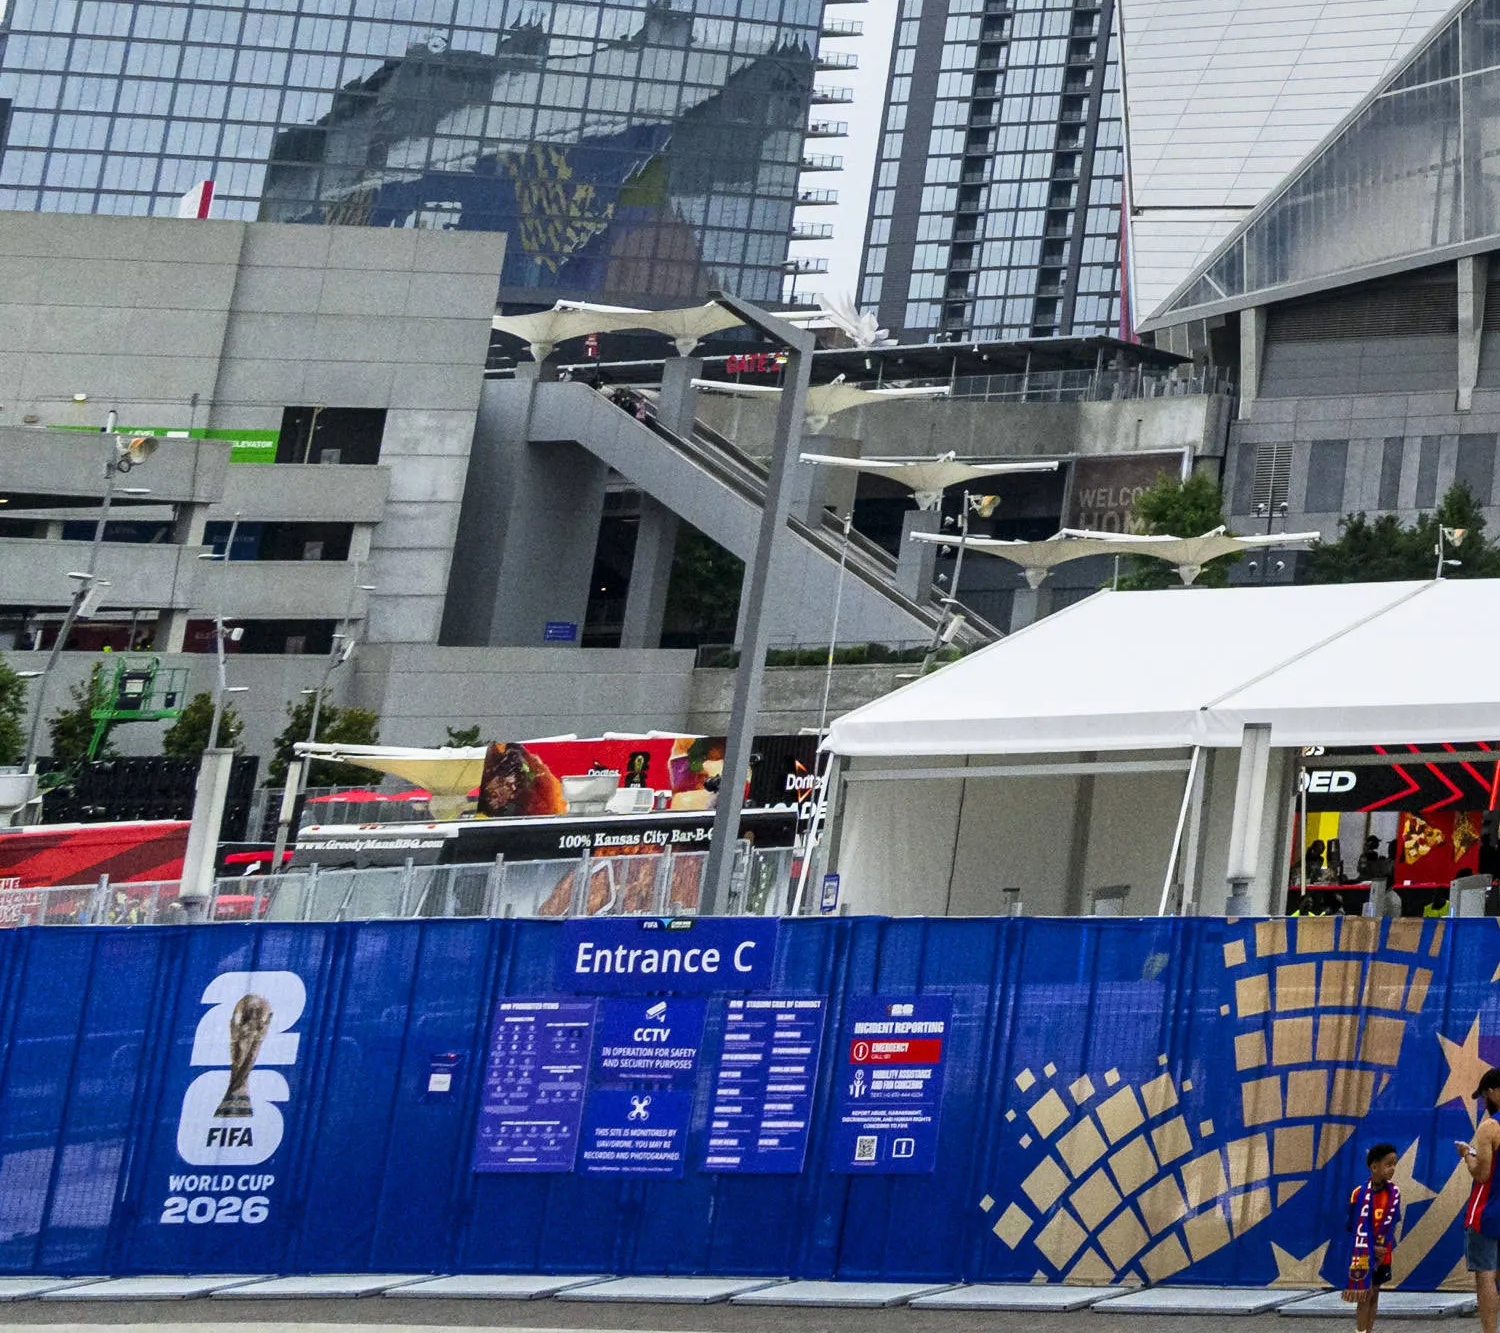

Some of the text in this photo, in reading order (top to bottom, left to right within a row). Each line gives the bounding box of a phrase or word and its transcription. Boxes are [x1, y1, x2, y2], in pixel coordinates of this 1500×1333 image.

[726, 354, 768, 374] GATE
[559, 834, 592, 849] 100%
[594, 832, 641, 848] Kansas
[643, 830, 670, 847] City
[575, 940, 757, 973] Entrance C
[854, 1021, 944, 1034] INCIDENT REPORTING
[633, 1028, 671, 1042] CCTV
[602, 1047, 696, 1058] IN OPERATION FOR SAFETY
[602, 1059, 692, 1069] AND SECURITY PURPOSES
[206, 1128, 253, 1147] FIFA
[595, 1128, 678, 1137] THIS SITE IS MONITORED BY
[634, 1140, 648, 1148] YOU
[648, 1141, 662, 1149] MAY
[663, 1141, 672, 1149] BE
[584, 1151, 615, 1160] RECORDED
[615, 1152, 629, 1160] AND
[168, 1174, 275, 1192] WORLD CUP
[160, 1196, 270, 1224] 2026
